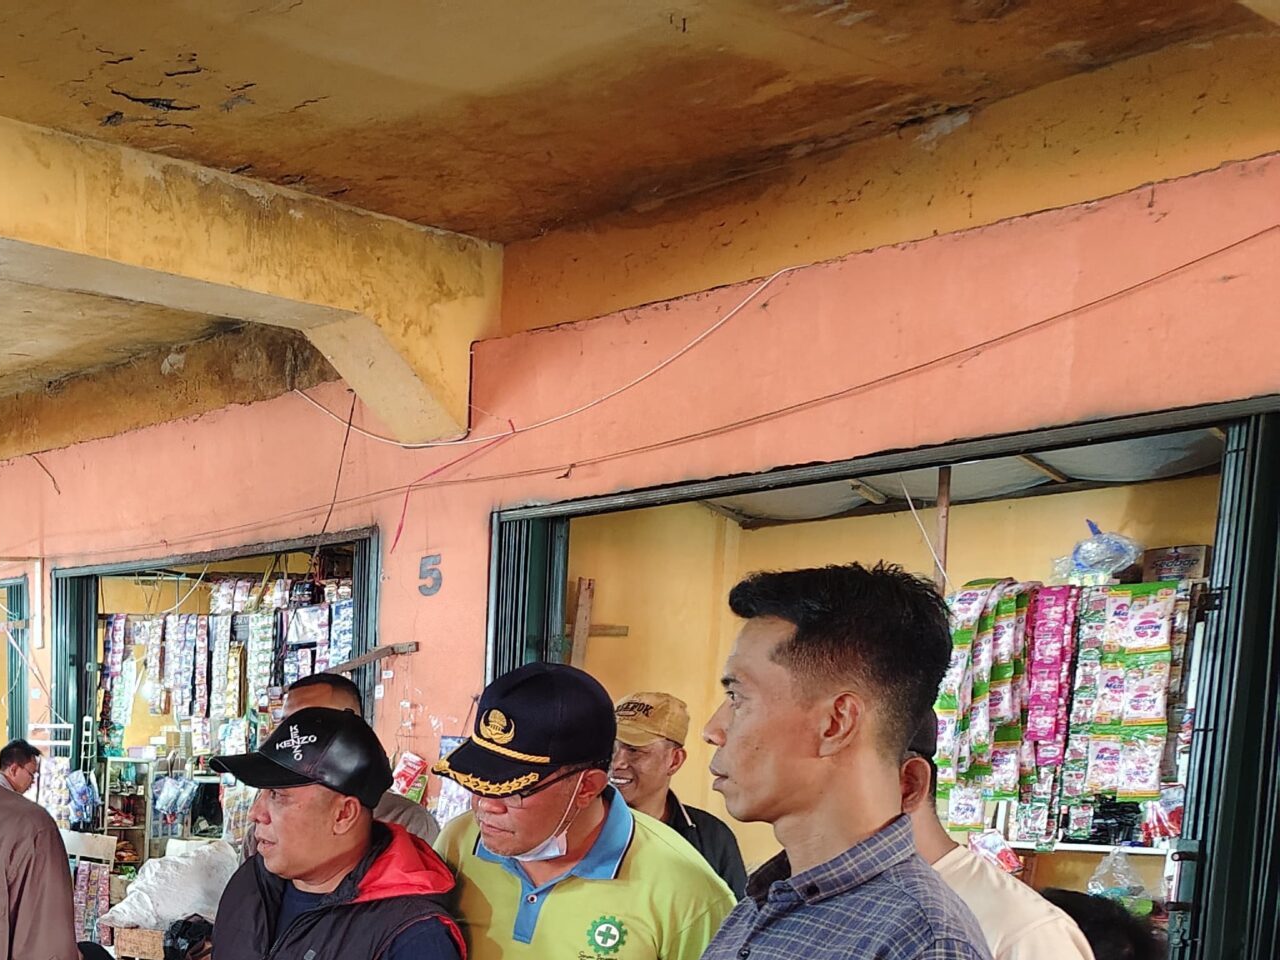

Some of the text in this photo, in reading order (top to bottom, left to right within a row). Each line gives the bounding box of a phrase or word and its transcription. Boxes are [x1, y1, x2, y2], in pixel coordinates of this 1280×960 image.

[418, 553, 443, 597] 5
[275, 734, 318, 750] KENZO
[289, 724, 303, 761] KENZO
